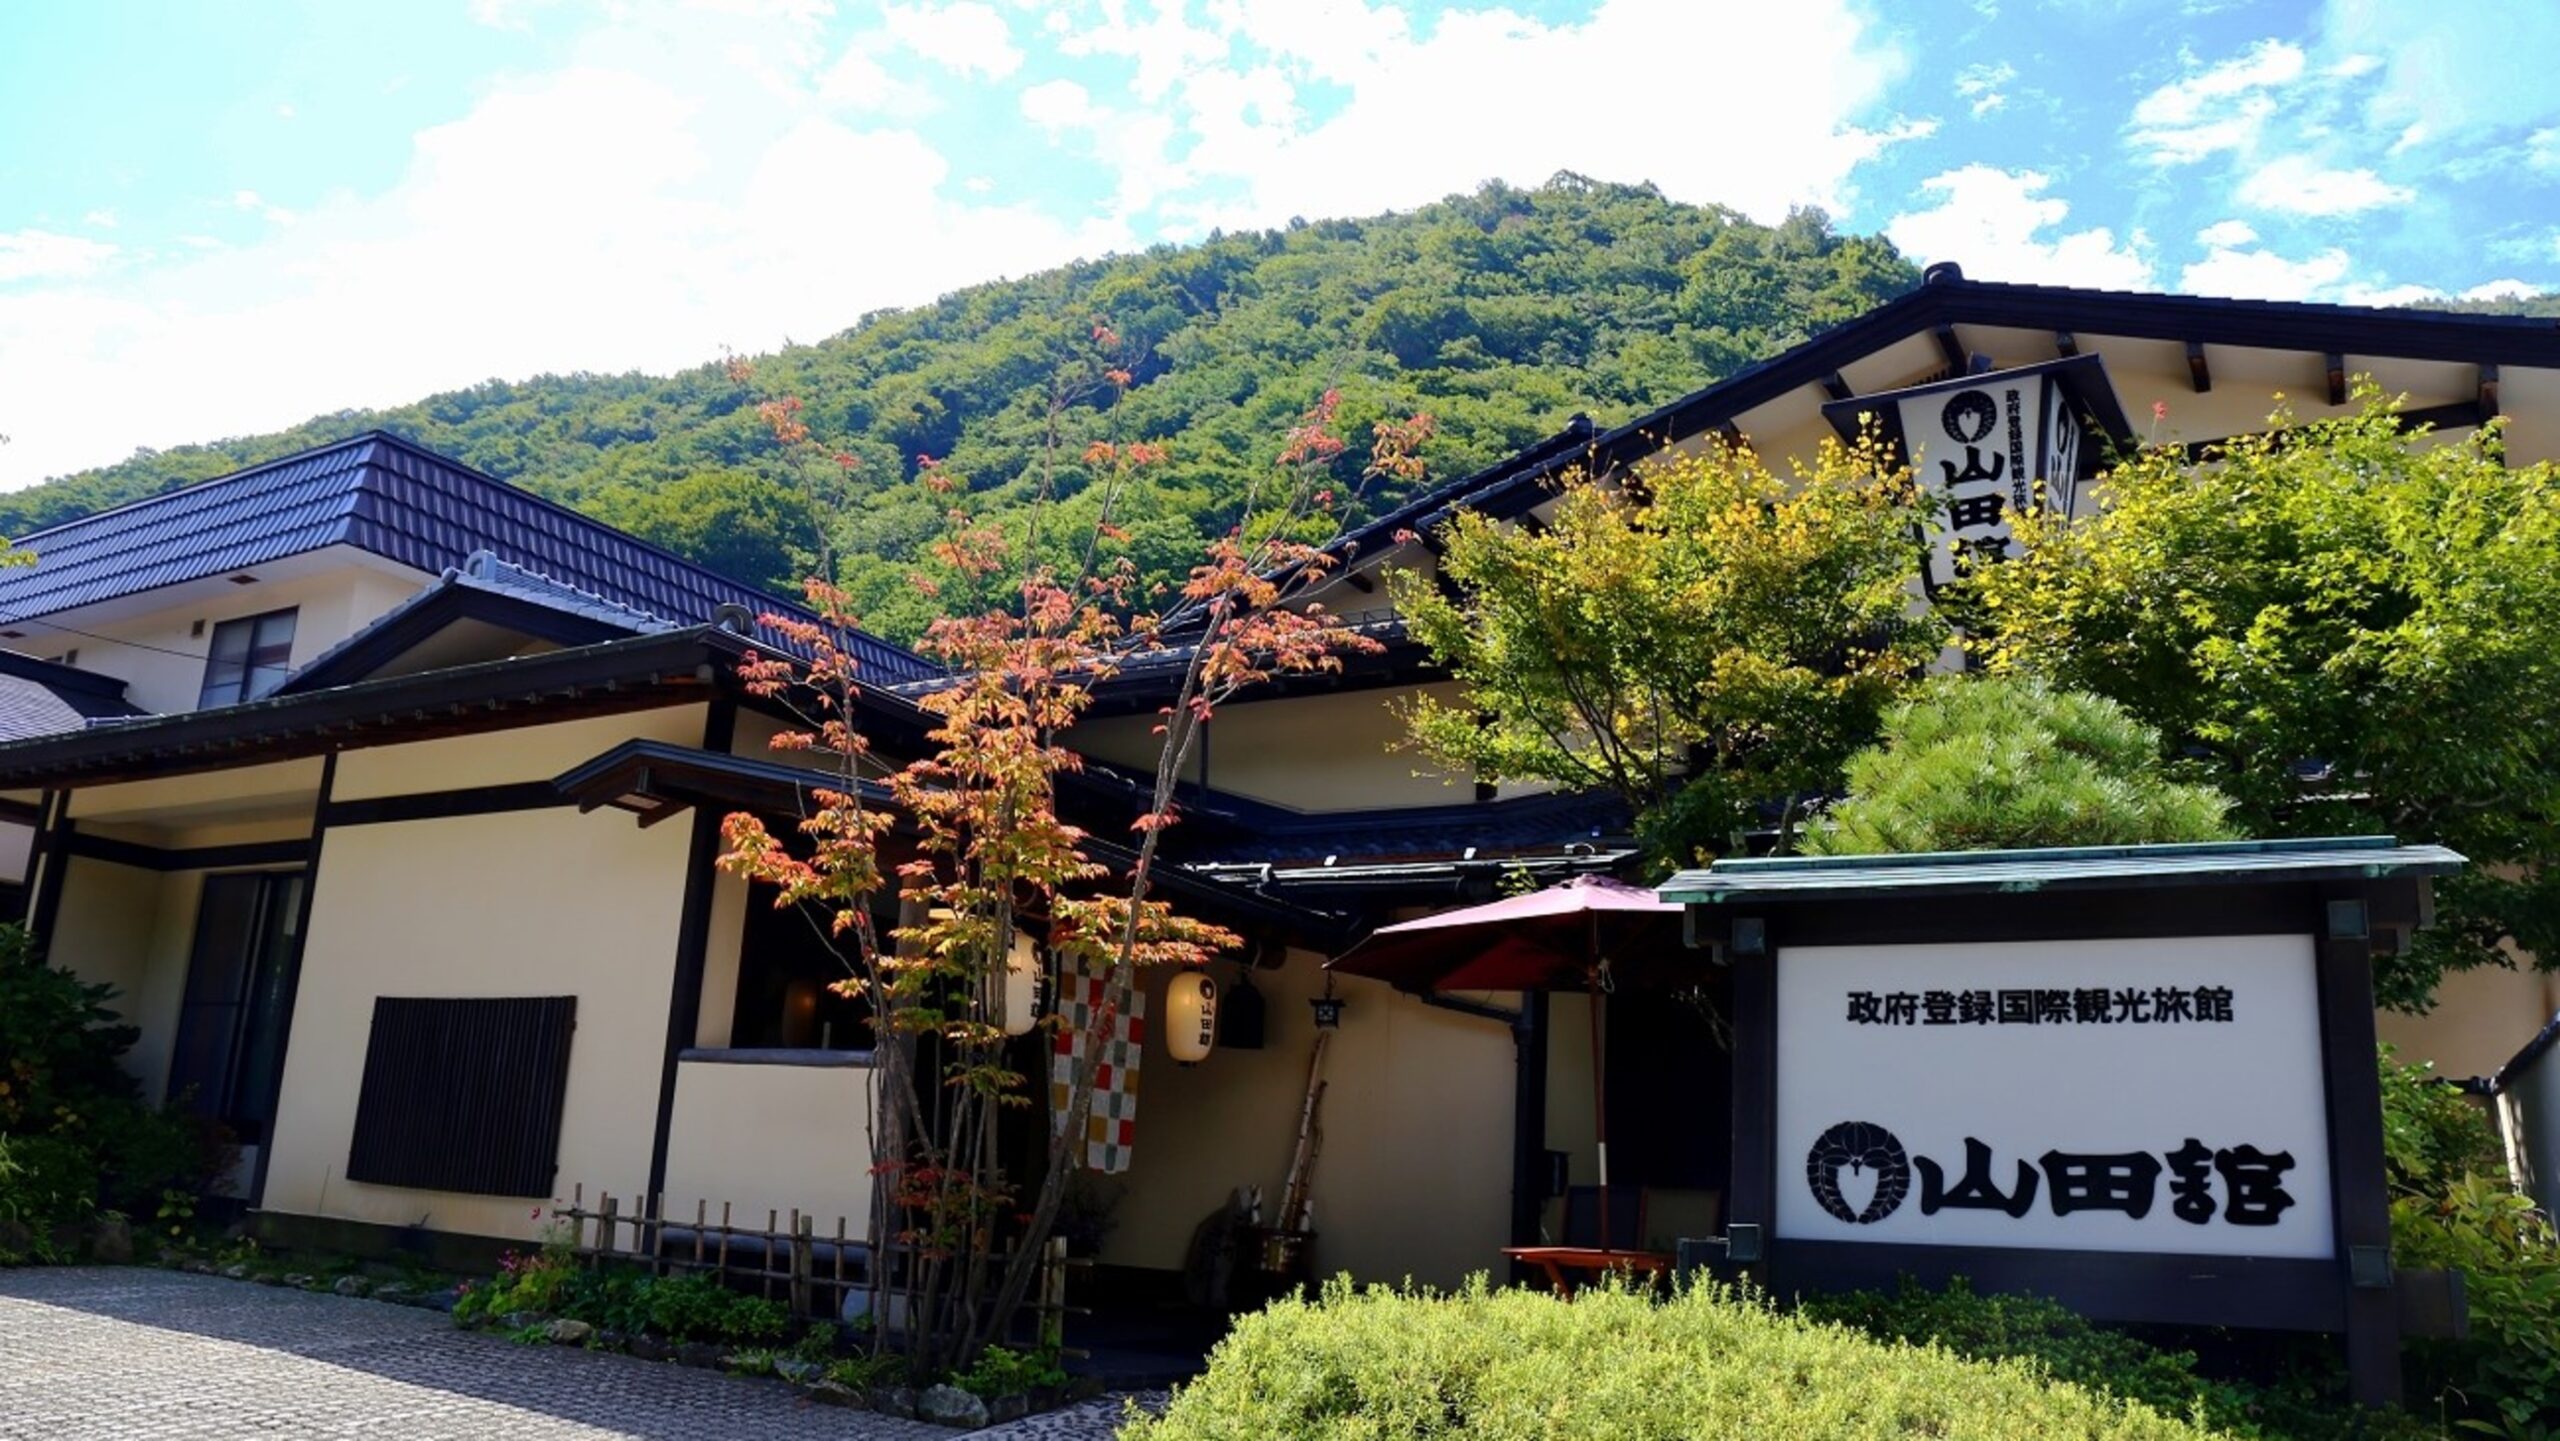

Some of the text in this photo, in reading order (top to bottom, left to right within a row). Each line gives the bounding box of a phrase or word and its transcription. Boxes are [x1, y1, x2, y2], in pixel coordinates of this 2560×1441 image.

[2006, 389, 2028, 518] 政府登録国際観光旅
[1846, 986, 2234, 1026] 政府登録国際観光旅館
